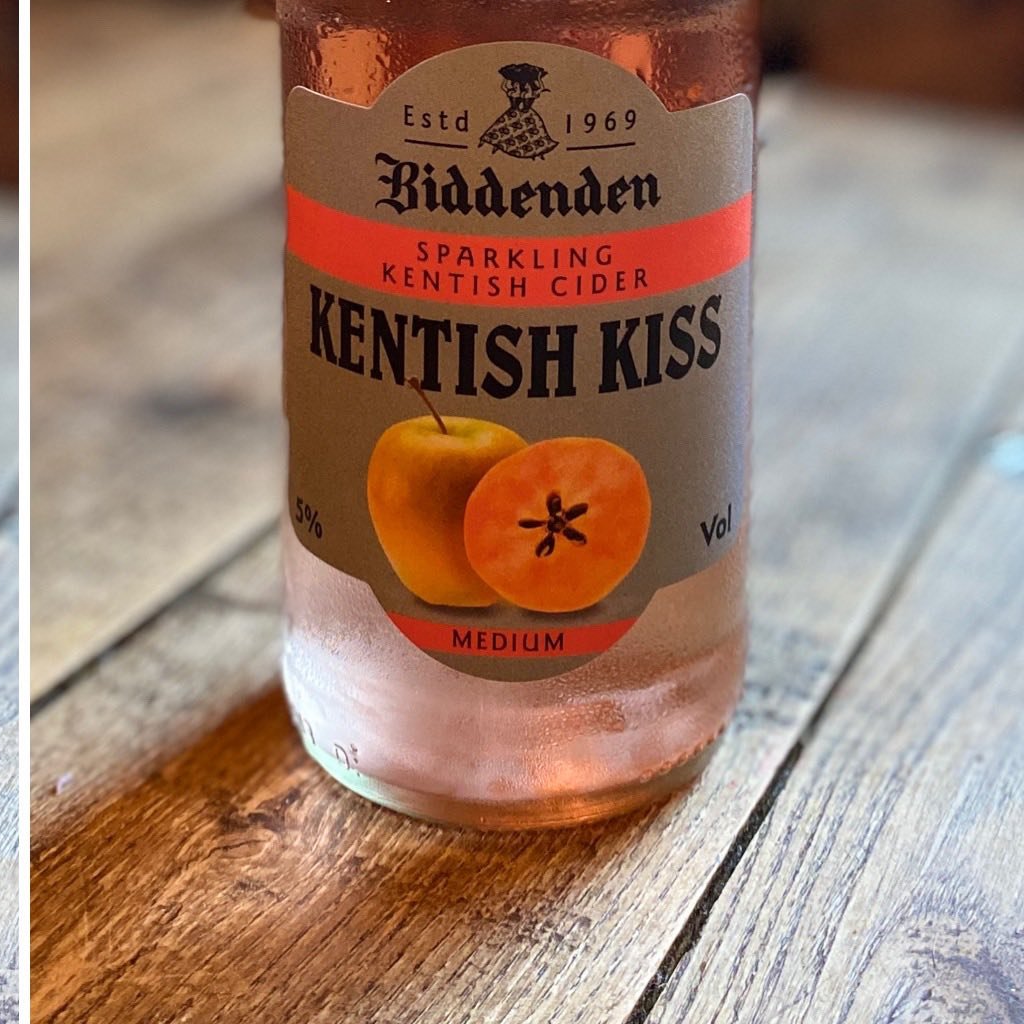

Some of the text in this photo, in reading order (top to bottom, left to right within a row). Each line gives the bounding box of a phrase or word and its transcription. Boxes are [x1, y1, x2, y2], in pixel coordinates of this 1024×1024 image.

[404, 105, 637, 134] Estd 1969
[375, 152, 661, 219] Biddenden
[417, 241, 612, 270] SPARKLING
[382, 263, 648, 297] KENTISH CIDER
[310, 284, 722, 399] KENTISH KISS
[296, 496, 323, 540] 5%
[700, 504, 732, 547] Vol
[452, 629, 565, 652] MEDIUM
